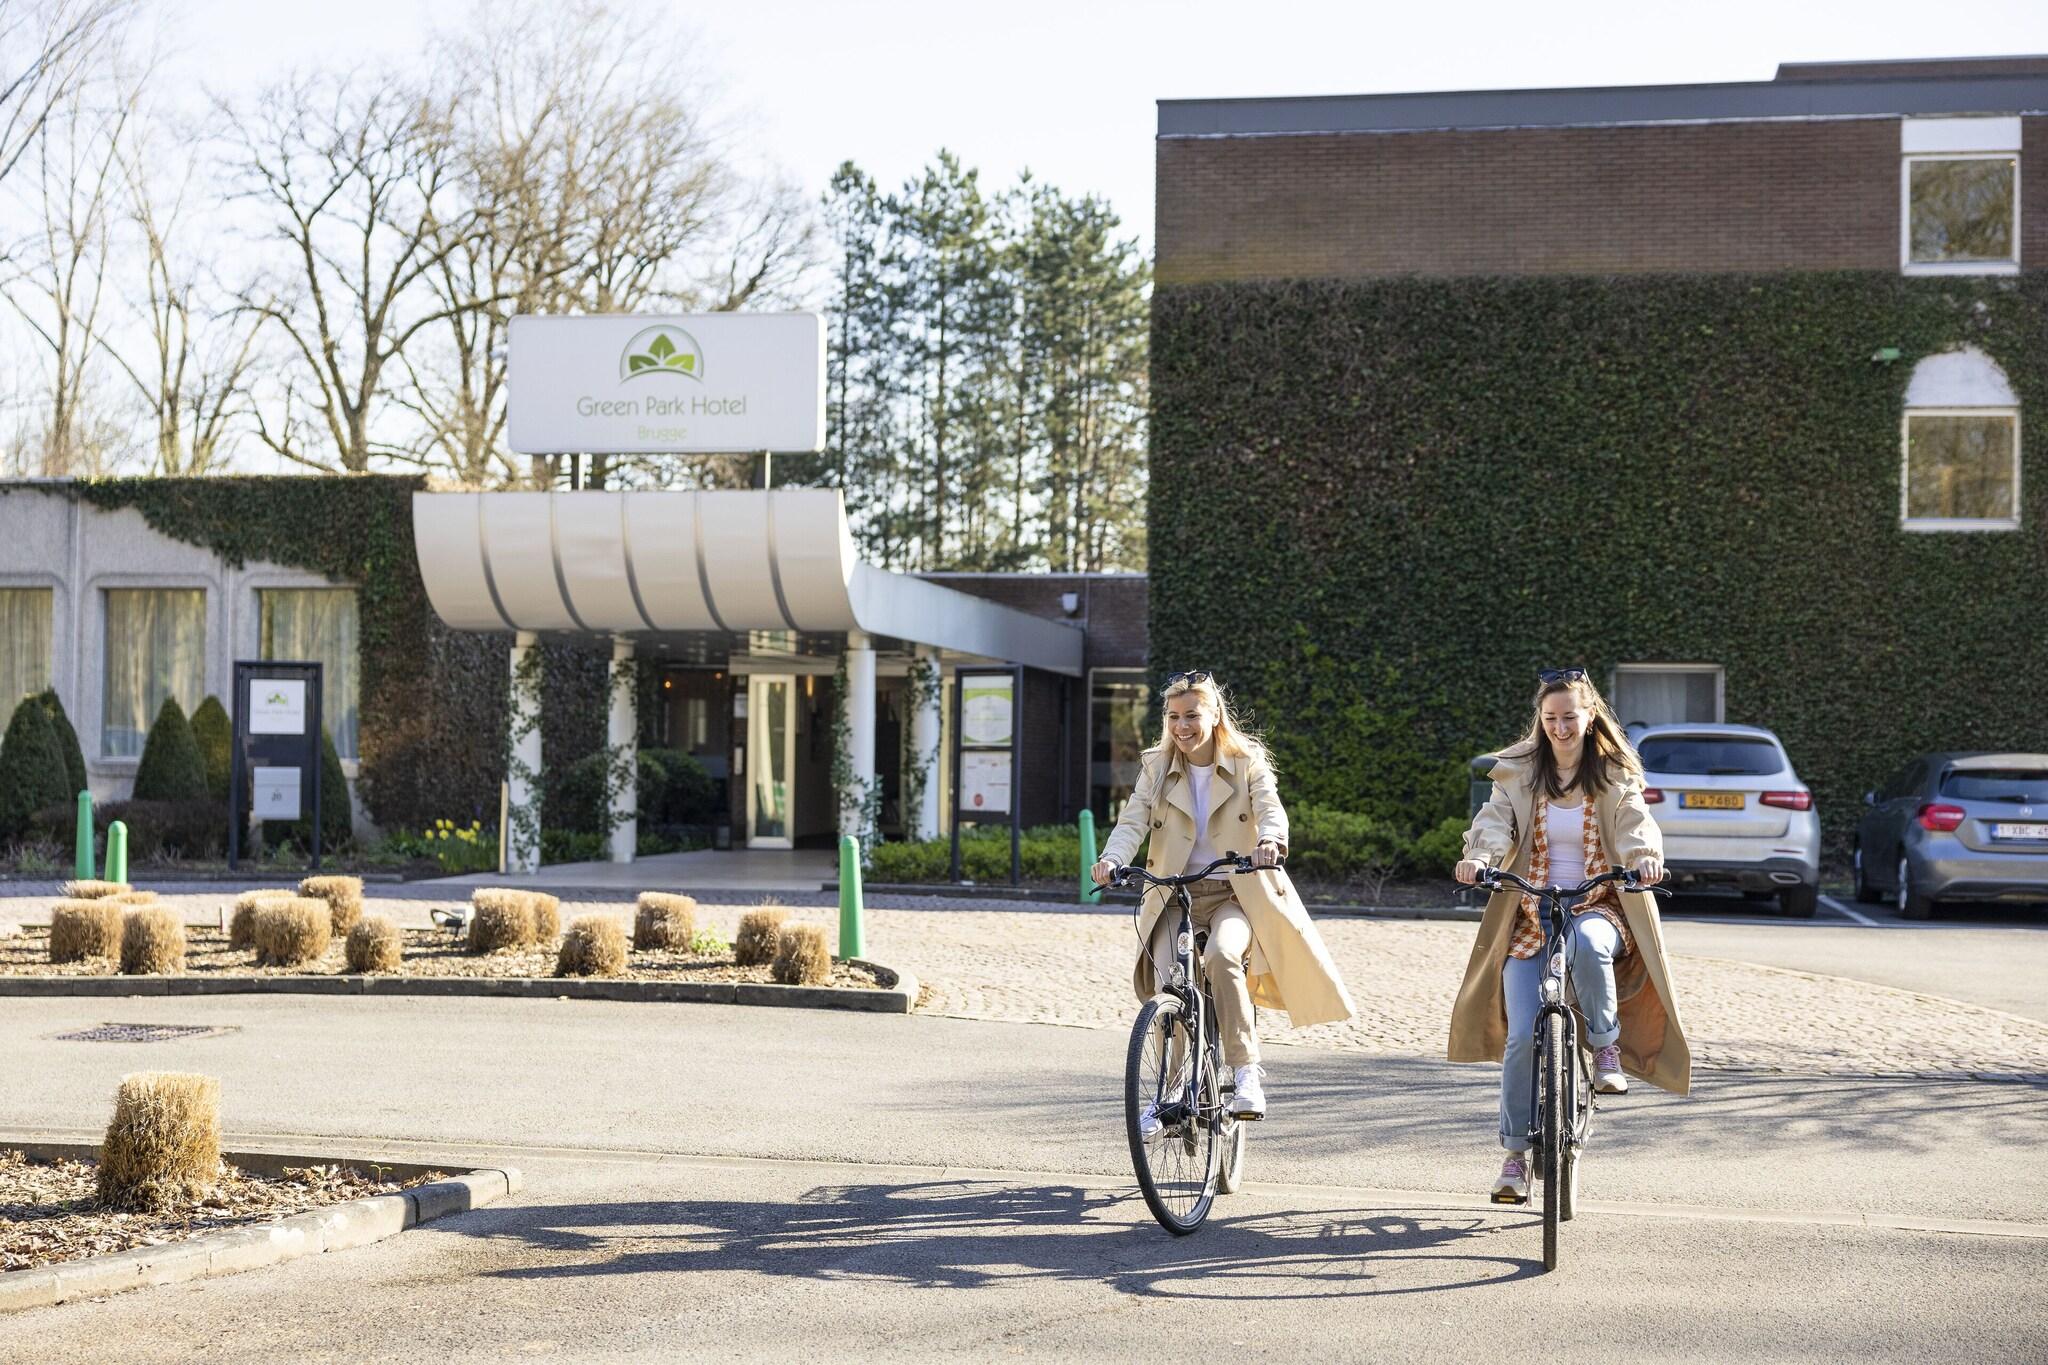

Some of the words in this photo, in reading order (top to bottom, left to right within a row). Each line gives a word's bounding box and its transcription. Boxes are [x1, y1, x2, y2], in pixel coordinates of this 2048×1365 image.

[576, 396, 639, 417] Green
[646, 395, 685, 416] Park
[691, 395, 747, 416] Hotel
[637, 425, 687, 441] Brugge
